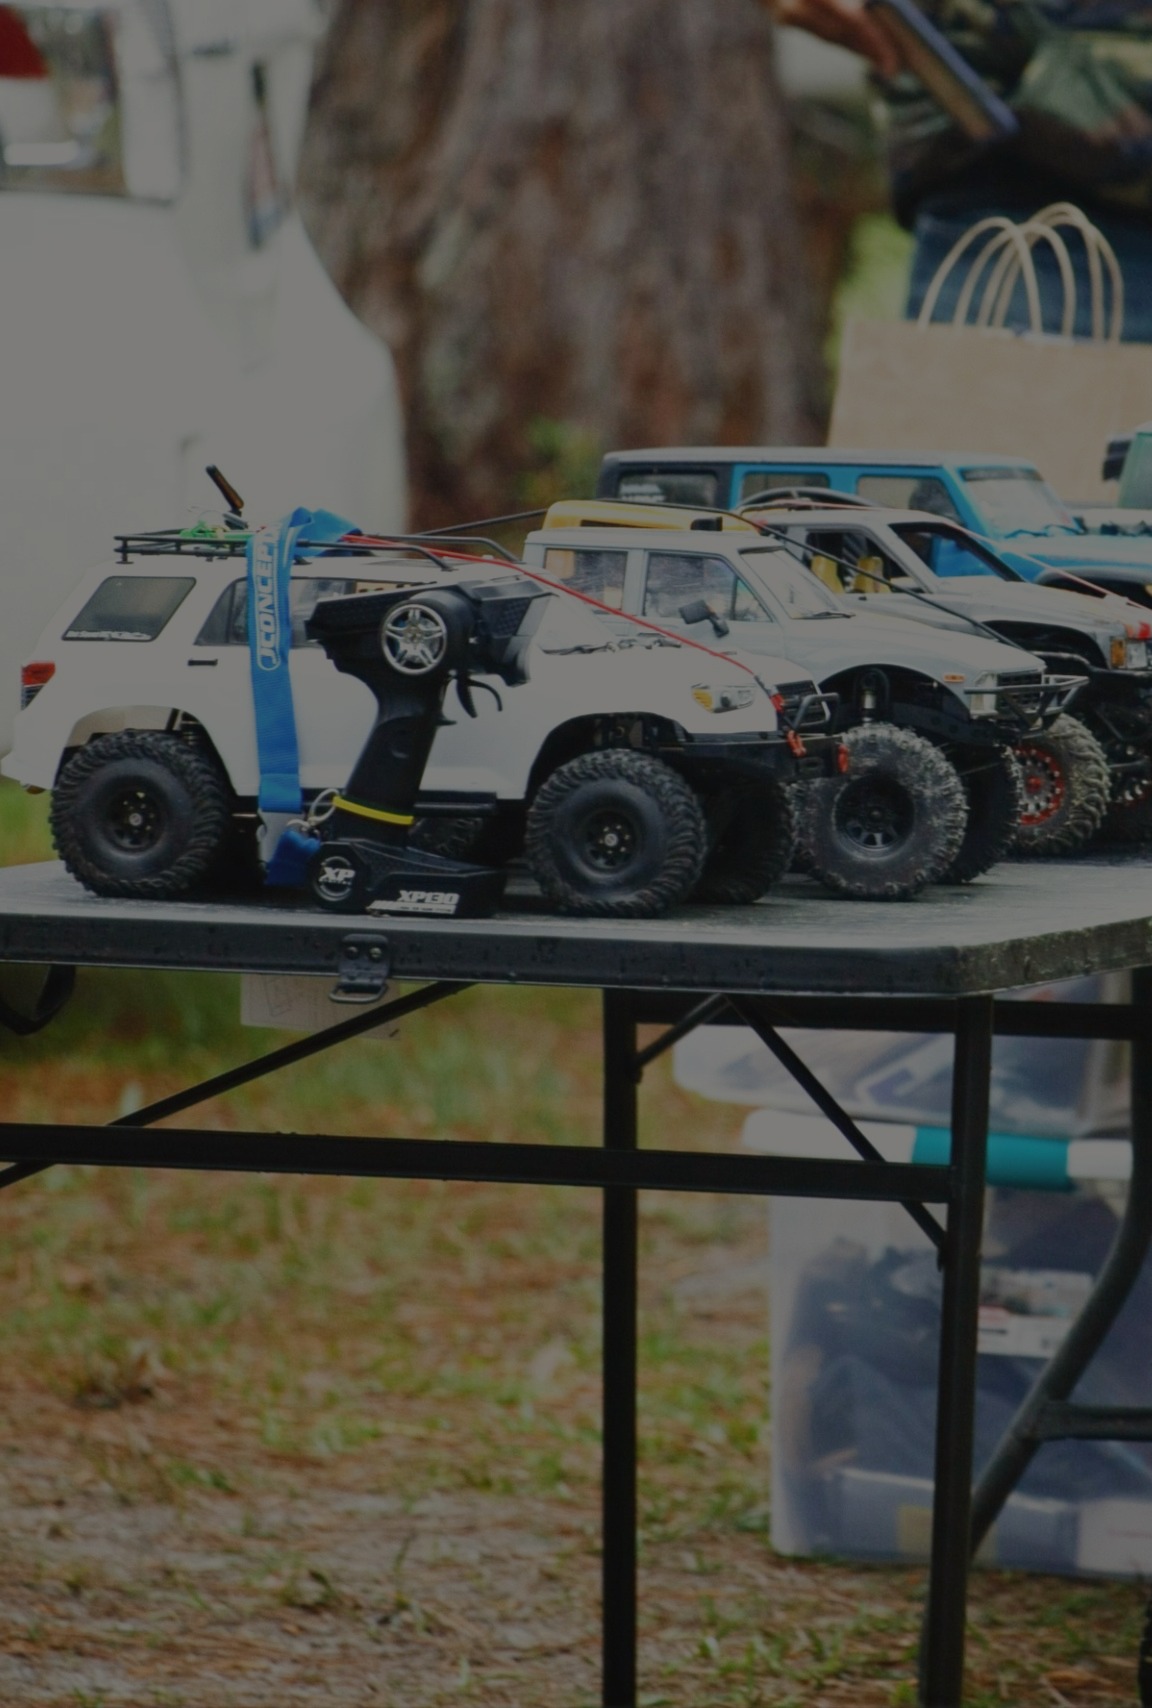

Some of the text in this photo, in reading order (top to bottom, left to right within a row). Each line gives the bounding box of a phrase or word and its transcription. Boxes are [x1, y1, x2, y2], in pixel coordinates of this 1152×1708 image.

[257, 522, 278, 665] JCONCEPT
[319, 867, 356, 882] XP
[397, 890, 460, 904] XP130
